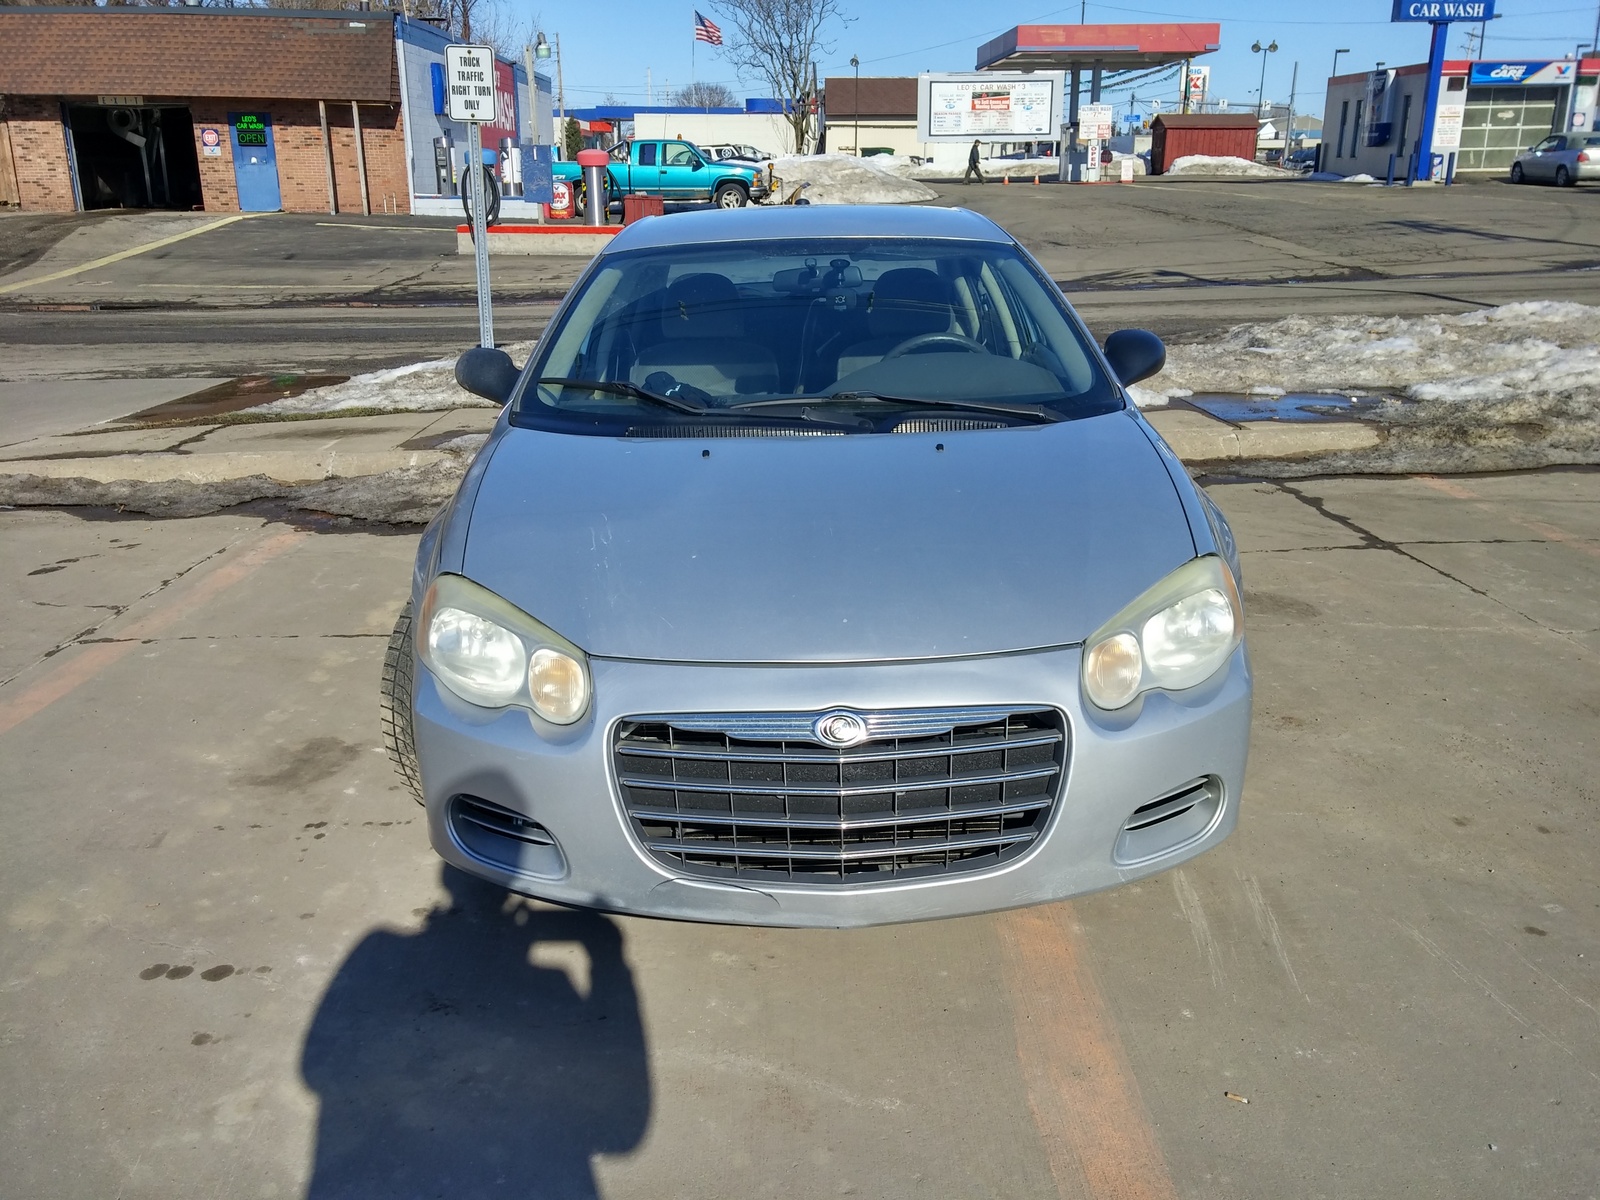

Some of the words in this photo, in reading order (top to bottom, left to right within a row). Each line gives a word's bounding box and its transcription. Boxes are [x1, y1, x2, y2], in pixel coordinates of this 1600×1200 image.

[1409, 3, 1440, 17] CAR
[1444, 3, 1485, 17] WASH
[460, 56, 480, 67] TRUCK
[458, 71, 484, 82] TRAFFIC
[1490, 69, 1526, 78] CARE
[452, 84, 470, 96] RIGHT
[474, 86, 492, 96] TURN
[464, 100, 480, 110] ONLY
[240, 134, 264, 144] OPEN
